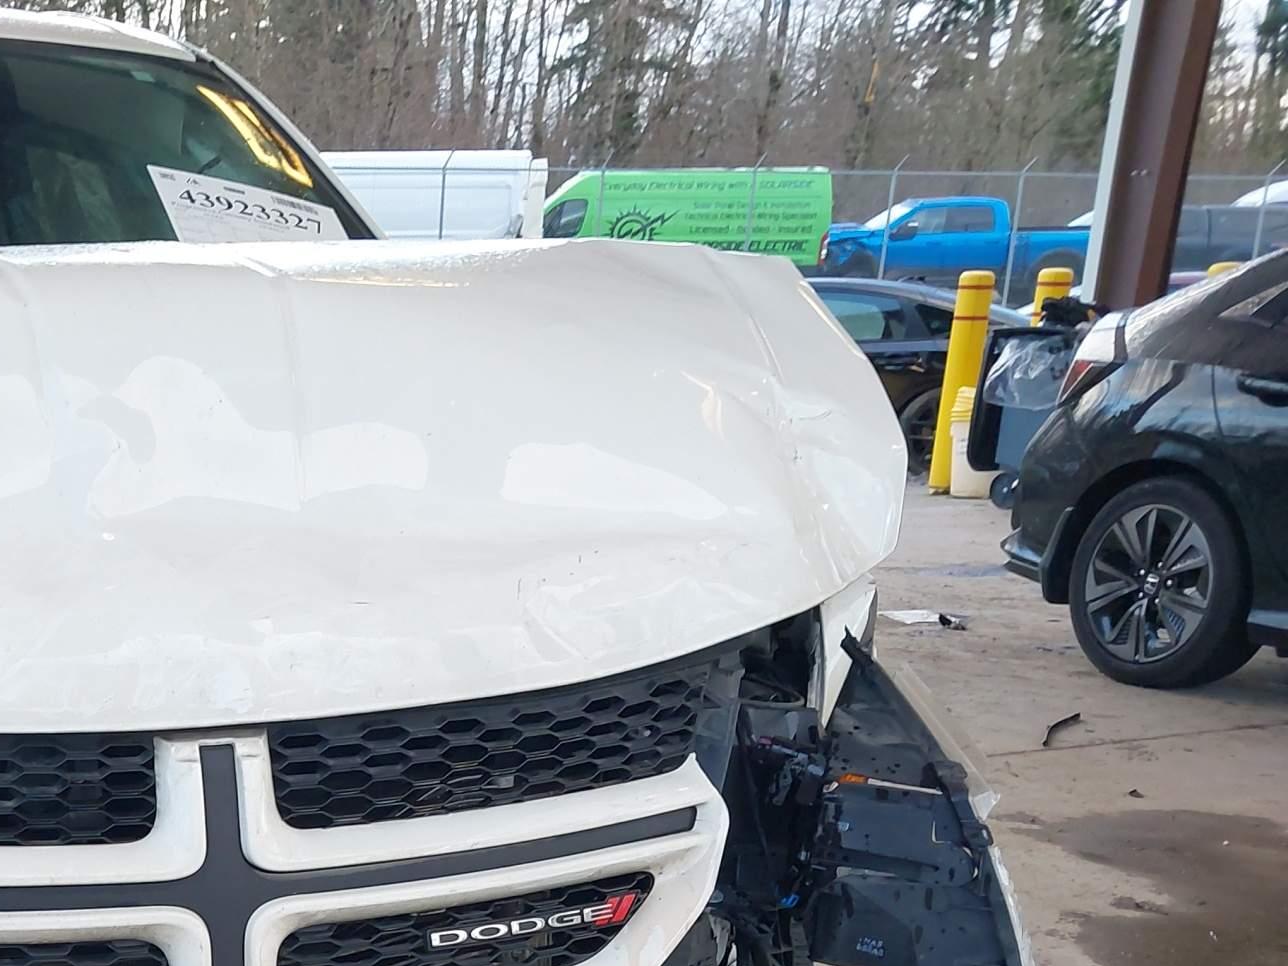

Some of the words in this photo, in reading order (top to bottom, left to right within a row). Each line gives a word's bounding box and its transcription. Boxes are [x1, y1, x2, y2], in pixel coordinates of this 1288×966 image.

[648, 181, 694, 191] Electrical
[178, 189, 321, 234] 43923327
[689, 225, 729, 234] Licensed
[736, 225, 769, 234] Boded
[778, 225, 812, 234] Insured
[748, 239, 809, 252] ELECTRIC
[430, 903, 614, 947] DODGE
